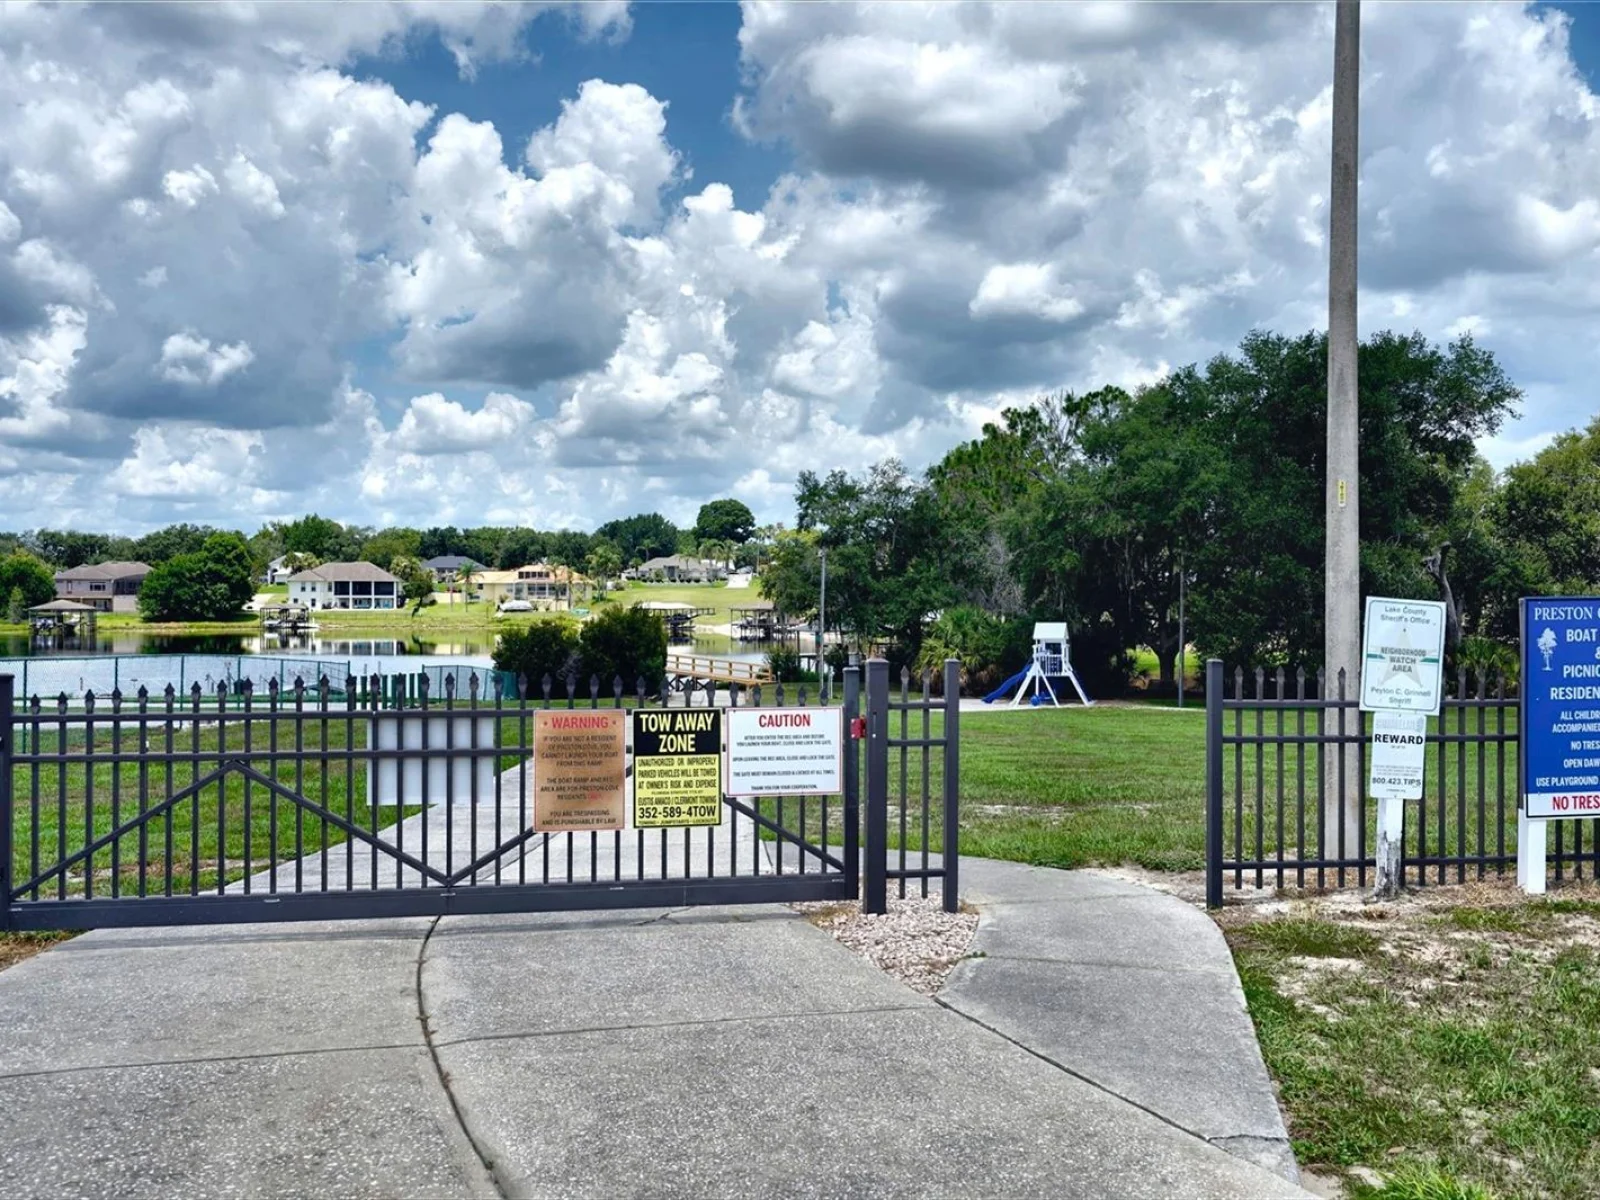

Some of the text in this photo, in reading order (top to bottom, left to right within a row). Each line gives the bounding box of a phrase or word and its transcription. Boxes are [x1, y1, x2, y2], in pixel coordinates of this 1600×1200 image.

[1403, 607, 1426, 616] County
[1534, 606, 1593, 620] PRESTON
[1381, 614, 1430, 624] Sheriff's Office
[1566, 628, 1598, 642] BOAT
[1381, 647, 1426, 656] NEIGHBORHOOD
[1390, 656, 1416, 664] WATCH
[1563, 664, 1600, 678] PICNIC
[1370, 686, 1394, 695] Peyton
[1404, 688, 1431, 696] Grinnell
[1550, 686, 1600, 700] RESIDEN
[759, 714, 811, 728] CAUTION
[1560, 711, 1573, 720] ALL
[552, 716, 609, 729] WARNING
[640, 712, 714, 732] TOW AWAY
[658, 734, 696, 752] ZONE
[1374, 734, 1423, 744] REWARD
[1571, 740, 1600, 751] NO TRES
[638, 757, 716, 766] UNAUTHORIZED OR IMPROPERLY
[1564, 758, 1582, 769] OPEN
[638, 768, 716, 778] PARKED VEHICLES WILL BE TOWED
[638, 779, 716, 789] AT OWNER'S RISK AND EXPENSE
[1536, 776, 1599, 787] USE PLAYGROUND
[699, 796, 716, 804] TOWING
[1553, 795, 1600, 810] NO TRES
[638, 806, 716, 818] 352-589-4TOW
